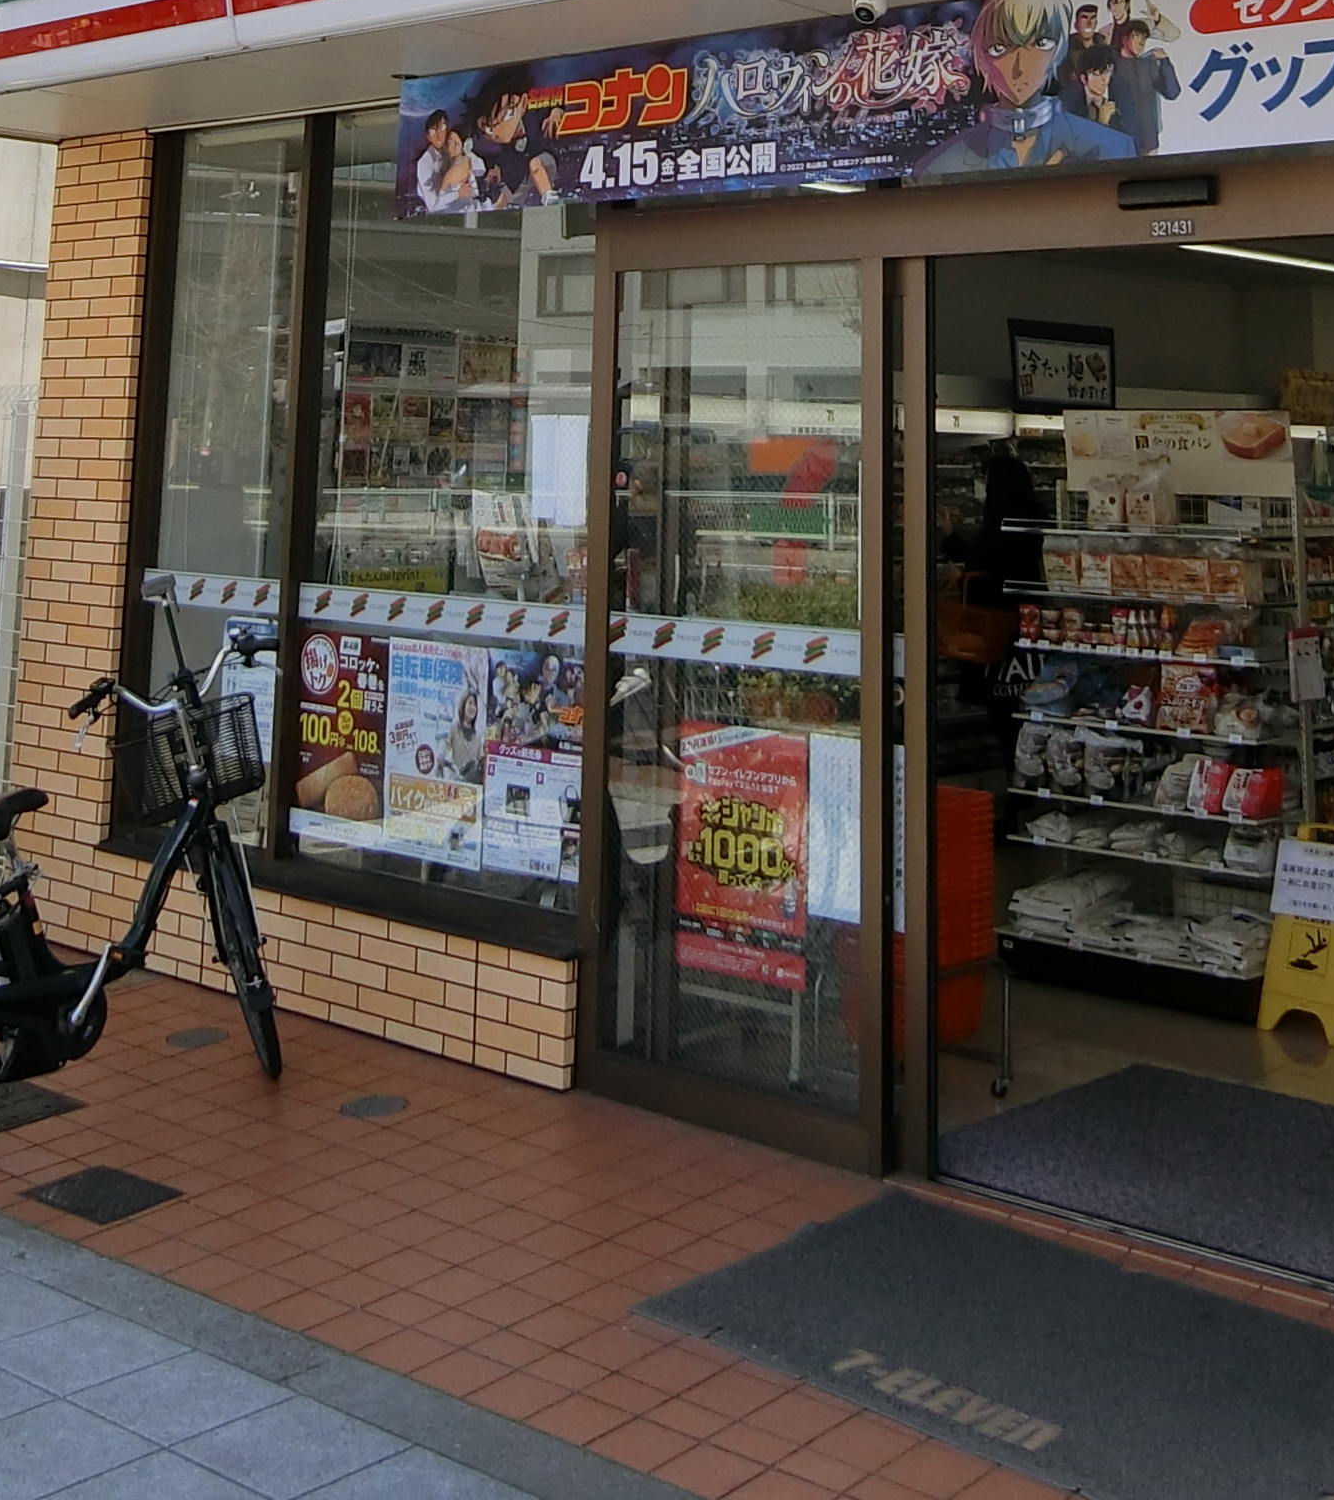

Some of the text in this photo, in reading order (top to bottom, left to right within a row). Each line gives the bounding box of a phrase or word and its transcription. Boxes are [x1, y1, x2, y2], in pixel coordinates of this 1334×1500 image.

[557, 64, 689, 135] コナン
[579, 140, 659, 191] 4.15
[676, 142, 777, 182] 全国公開
[1151, 219, 1193, 238] 321431
[391, 653, 464, 686] 自転車保険
